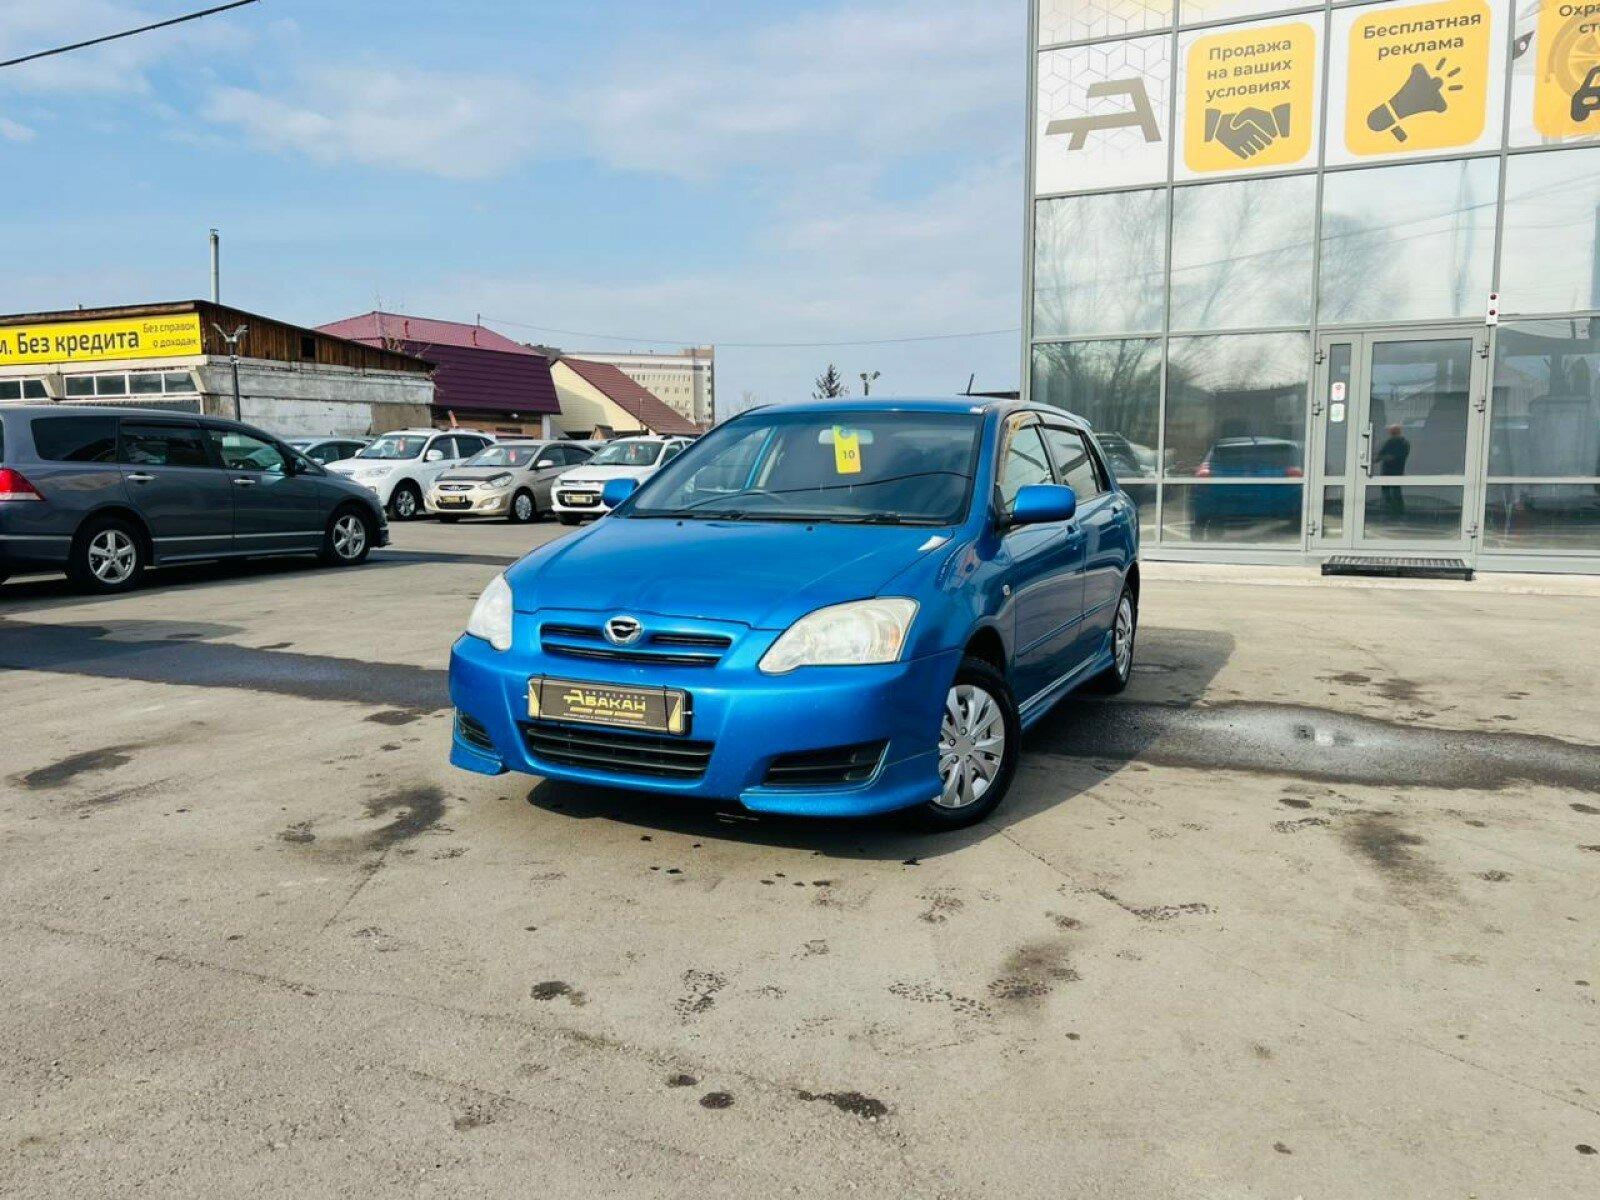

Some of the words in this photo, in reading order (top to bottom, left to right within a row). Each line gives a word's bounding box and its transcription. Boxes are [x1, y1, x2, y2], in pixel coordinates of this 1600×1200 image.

[1364, 13, 1481, 39] Бесплатная
[1209, 39, 1291, 61] Продажа
[1378, 36, 1464, 60] реклама
[1207, 68, 1228, 80] на
[1233, 59, 1292, 77] ваших
[1205, 79, 1291, 103] условиях
[17, 332, 50, 354] Без
[55, 331, 140, 358] кредита
[843, 449, 856, 460] 10
